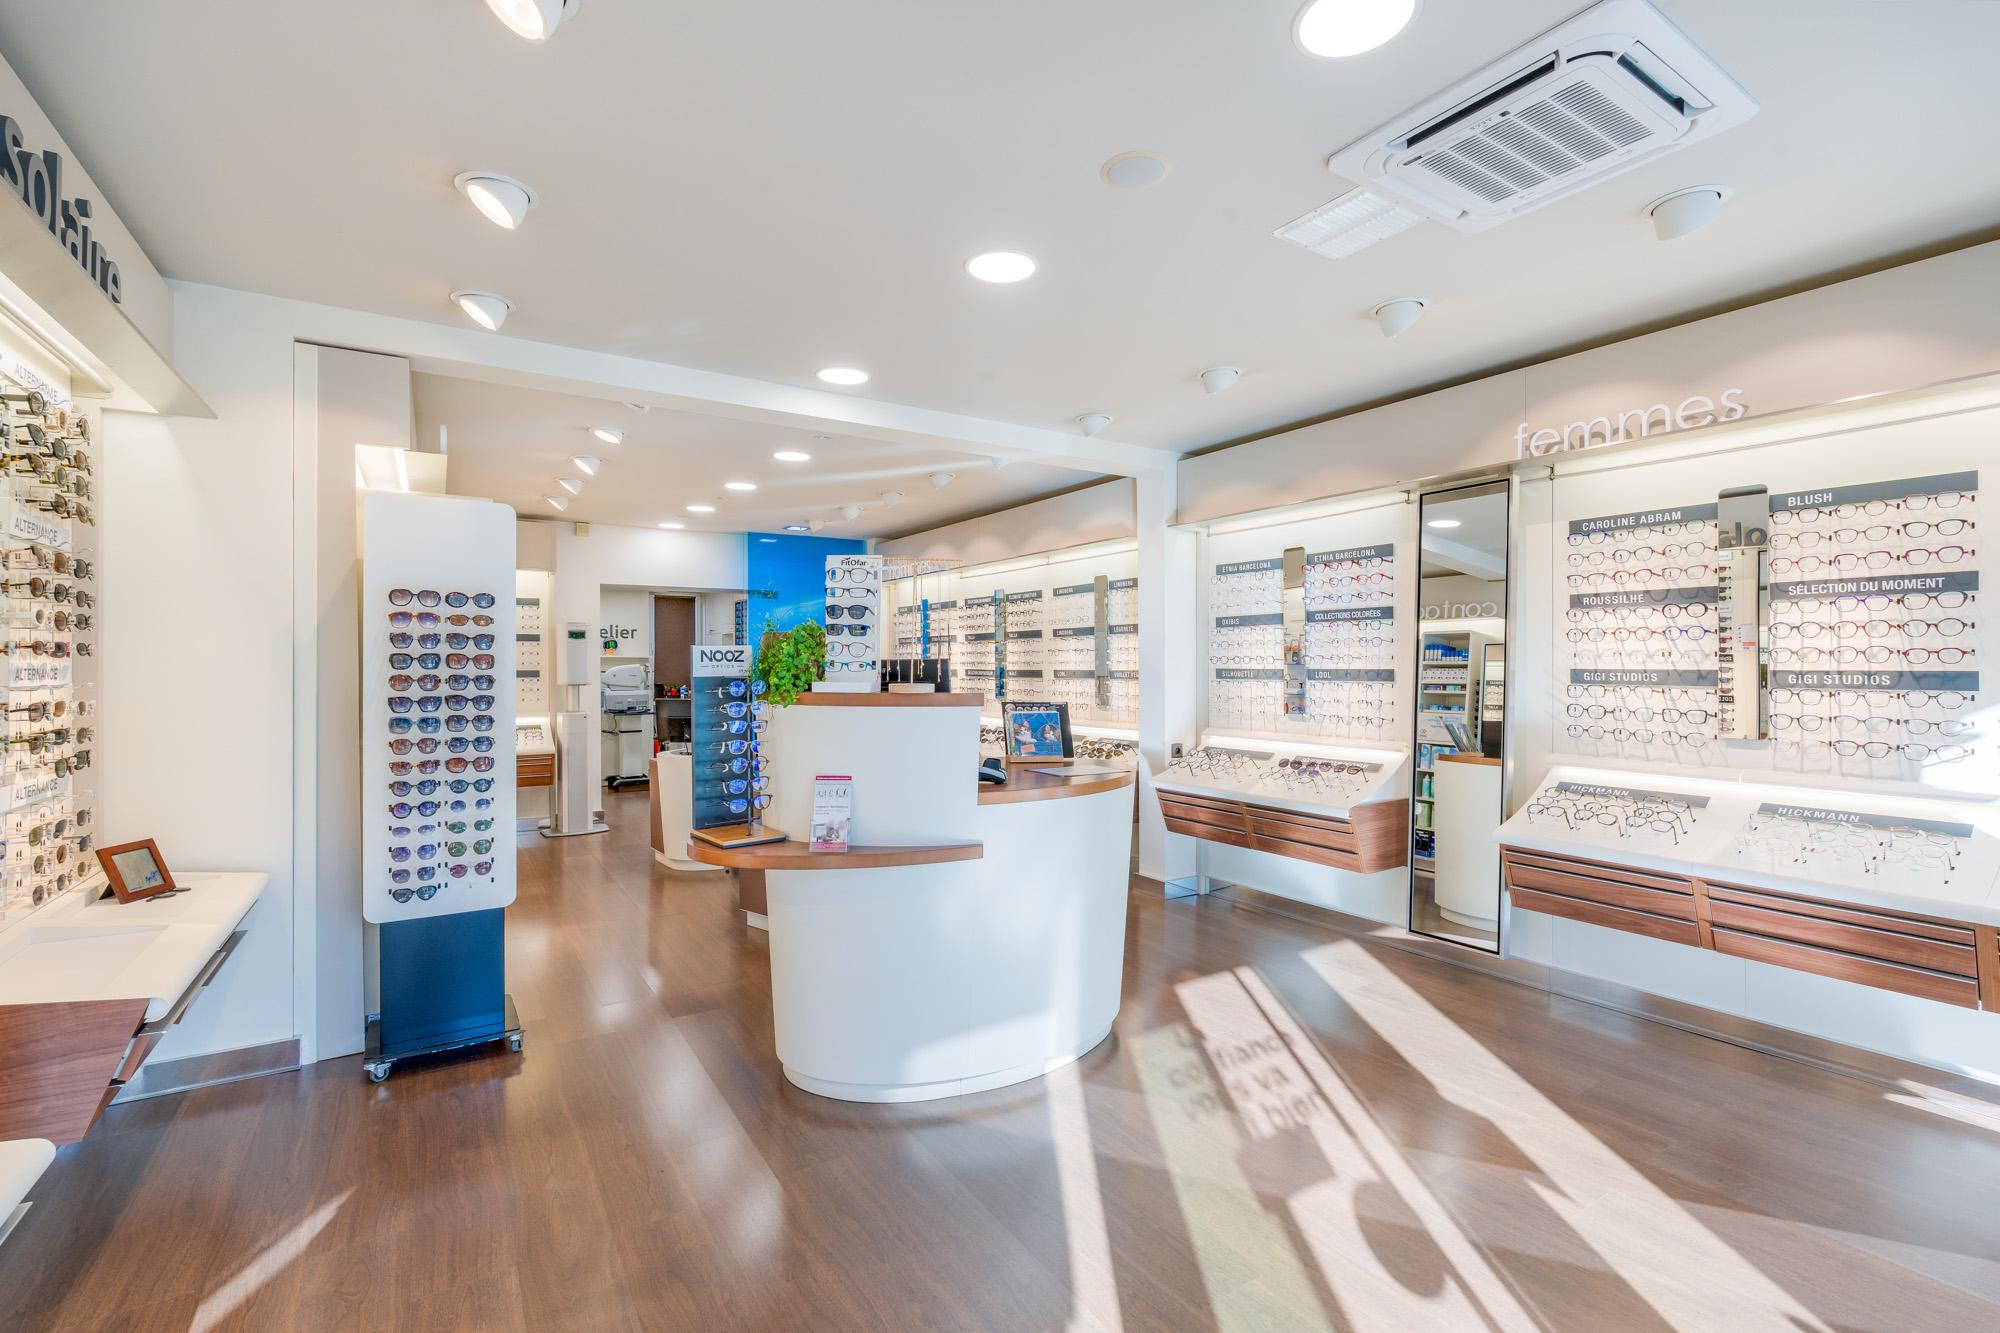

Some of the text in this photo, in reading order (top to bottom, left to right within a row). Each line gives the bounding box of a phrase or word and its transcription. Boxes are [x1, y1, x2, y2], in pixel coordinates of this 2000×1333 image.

[1513, 388, 1745, 460] femmes
[1787, 492, 1833, 507] BLUSH
[1582, 510, 1682, 531] CAROLINE ABRAM
[1314, 549, 1375, 563] ETNIA BARCELONA
[1788, 577, 1946, 596] SÉLECTION DU MOMENT
[1583, 594, 1645, 605] ROUSSILHE
[1315, 609, 1381, 620] COLLECTIONS COLORÉES
[701, 650, 744, 662] NOOZ
[1583, 672, 1658, 682] GIGI STUDIOS
[1788, 674, 1891, 685] GIGI STUDIOS
[15, 778, 58, 801] ALTERNANCE
[1777, 807, 1861, 822] HICKMANN
